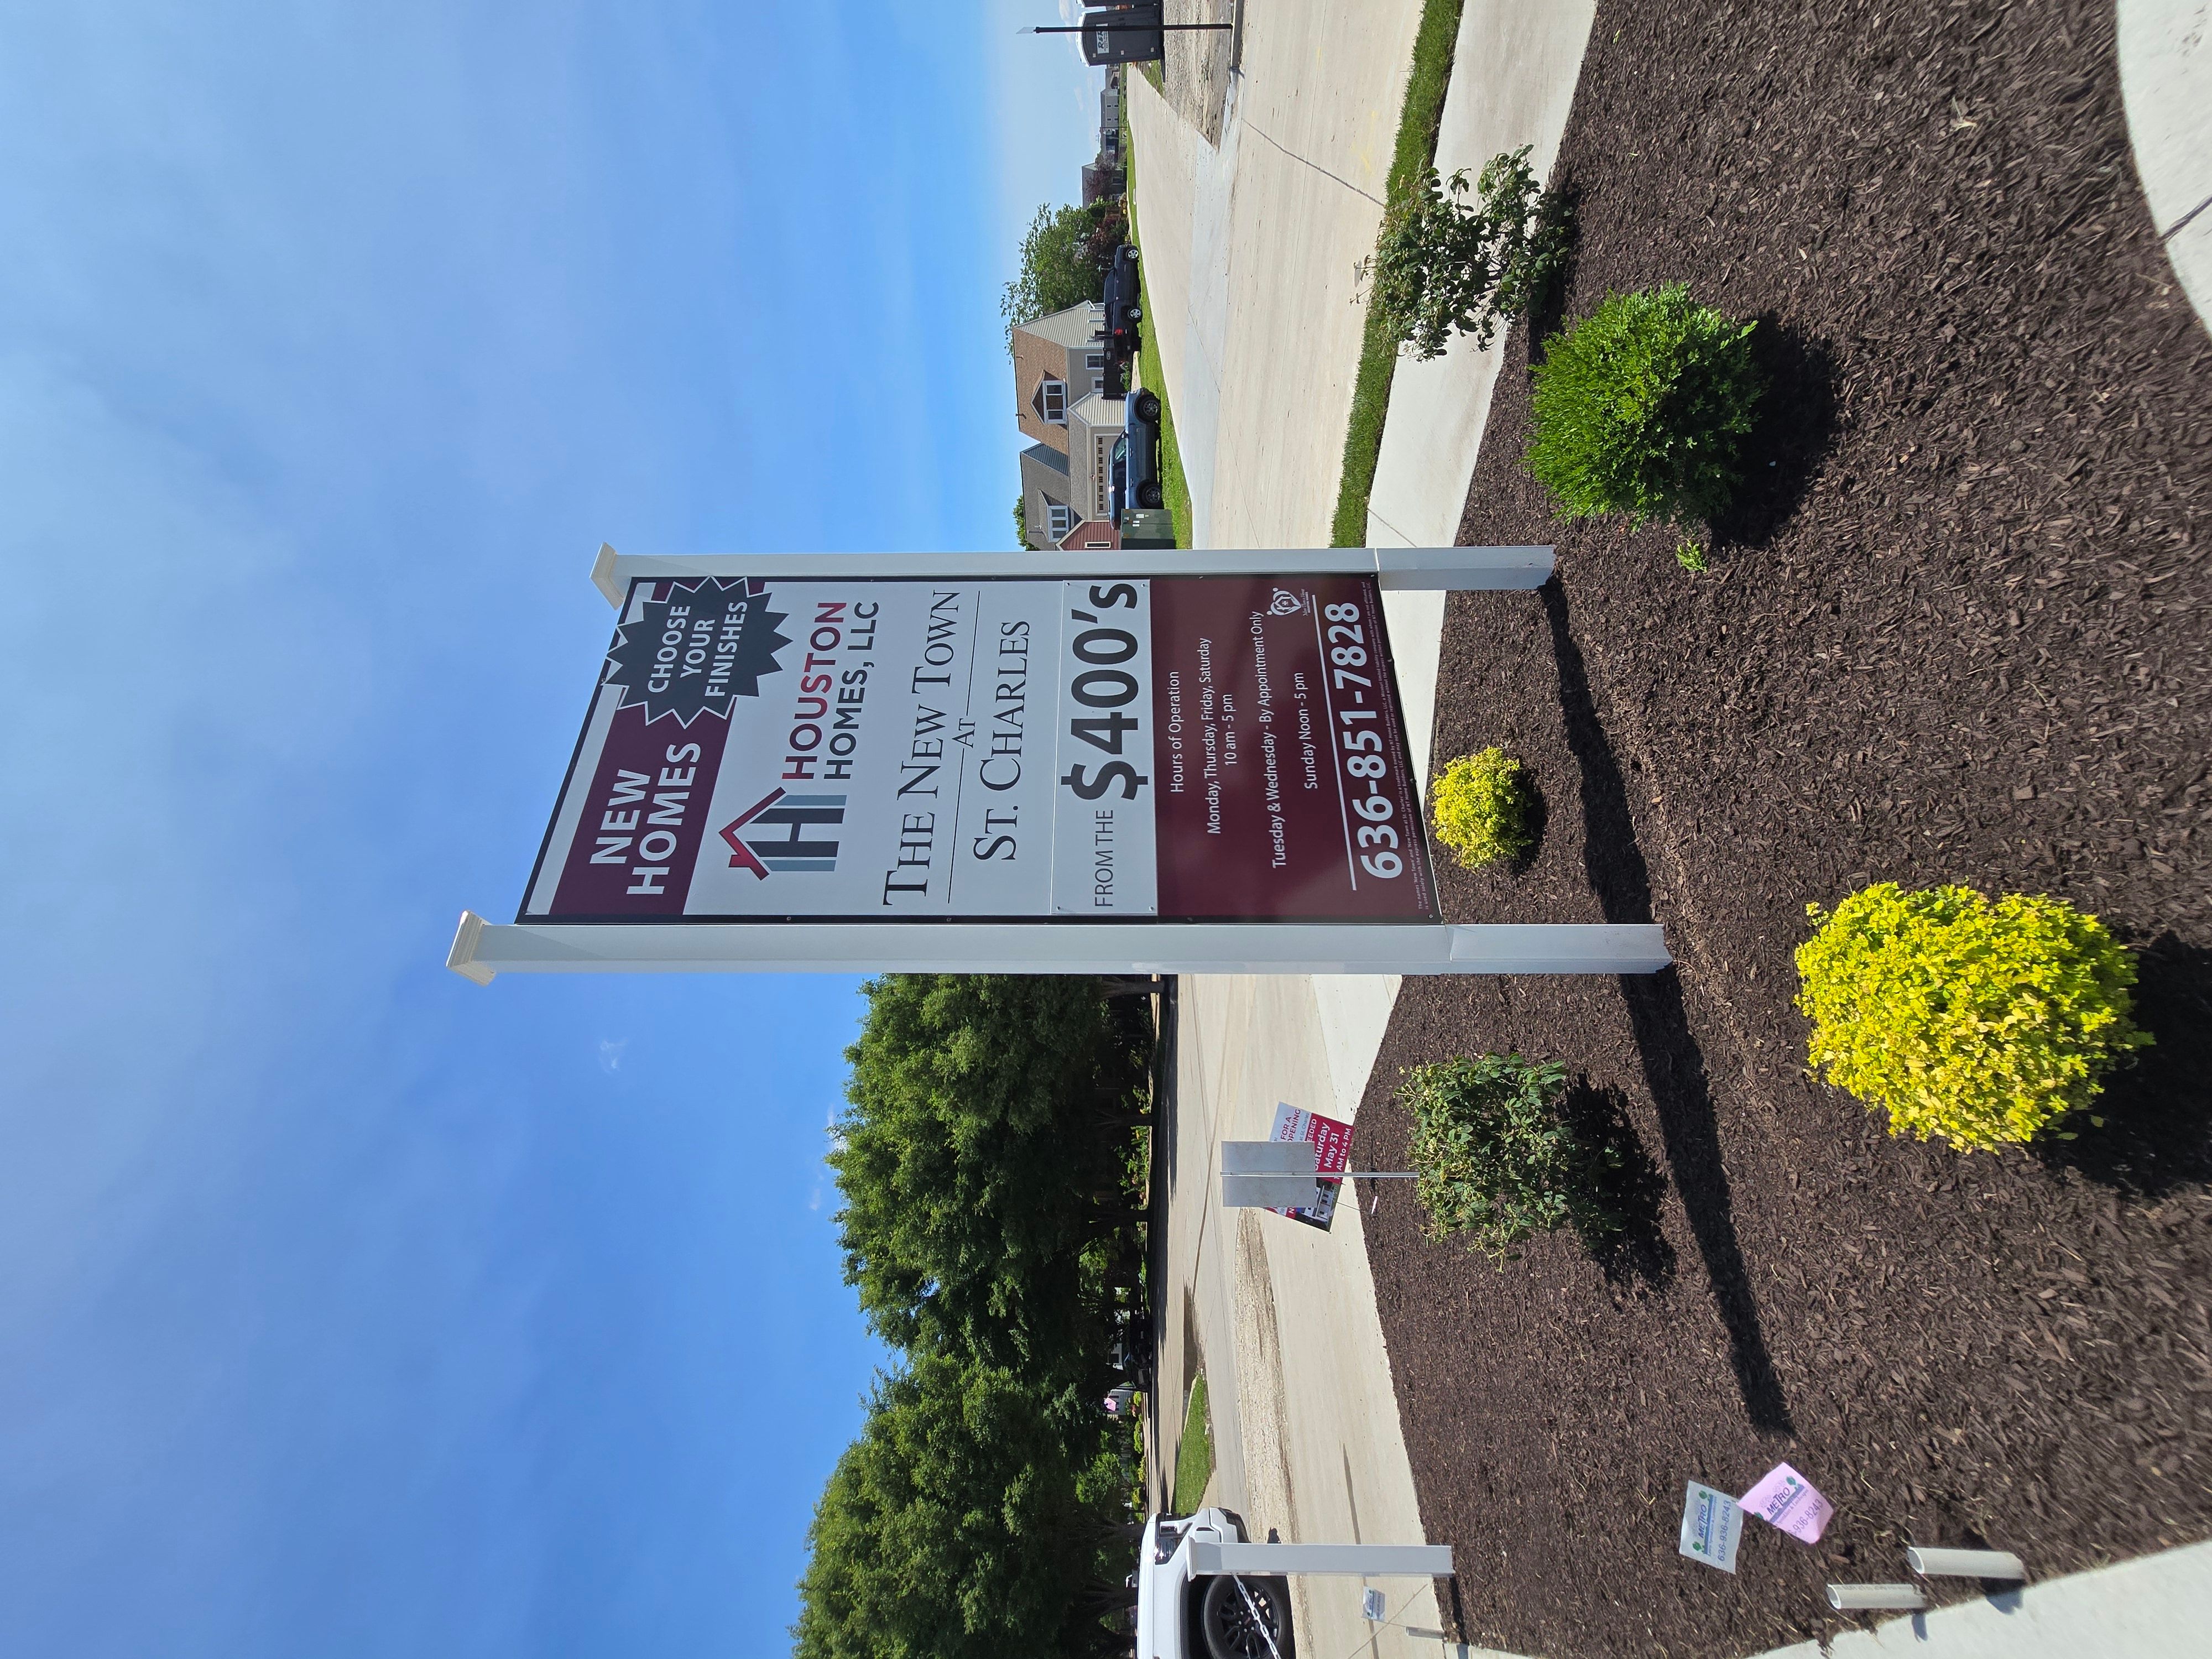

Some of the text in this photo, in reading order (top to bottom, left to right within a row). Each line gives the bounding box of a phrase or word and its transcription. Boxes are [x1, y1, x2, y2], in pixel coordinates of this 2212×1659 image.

[1249, 611, 1264, 634] Only
[648, 606, 691, 693] CHOOSE
[680, 619, 716, 678] YOUR
[705, 602, 748, 697] FINISHES
[781, 603, 847, 780] HOUSTON
[823, 602, 879, 780] HOMES, LLC
[1252, 637, 1272, 706] Appointment
[1293, 672, 1308, 690] pm
[1222, 694, 1237, 712] pm
[1259, 709, 1275, 722] By
[951, 718, 976, 749] AT
[973, 621, 1030, 861] ST. CHARLES
[1167, 671, 1185, 792] Hours of Operation
[1197, 638, 1222, 834] Monday, Thursday, Friday, Saturday
[1224, 732, 1237, 749] am
[1298, 709, 1312, 739] Noon
[1324, 603, 1403, 879] 636-851-7828
[883, 590, 960, 905] THE NEW TOWN
[1060, 583, 1148, 907] FROM THE $400's
[1224, 752, 1238, 766] 10
[1300, 742, 1318, 789] Sunday
[1260, 732, 1280, 801] Wednesday
[588, 769, 651, 865] NEW
[627, 743, 701, 895] HOMES
[1267, 802, 1281, 812] &
[1408, 813, 1417, 838] permission
[1269, 815, 1286, 868] Tuesday
[1280, 1124, 1290, 1140] FOR
[1307, 1118, 1317, 1141] EEDED
[1323, 1132, 1339, 1168] May 31
[1343, 1128, 1352, 1140] PM
[1336, 1157, 1344, 1171] AM
[1339, 1148, 1347, 1156] to
[1698, 1504, 1708, 1538] METRO
[1766, 1487, 1790, 1515] METRO
[1717, 1500, 1731, 1562] 636-936-8243
